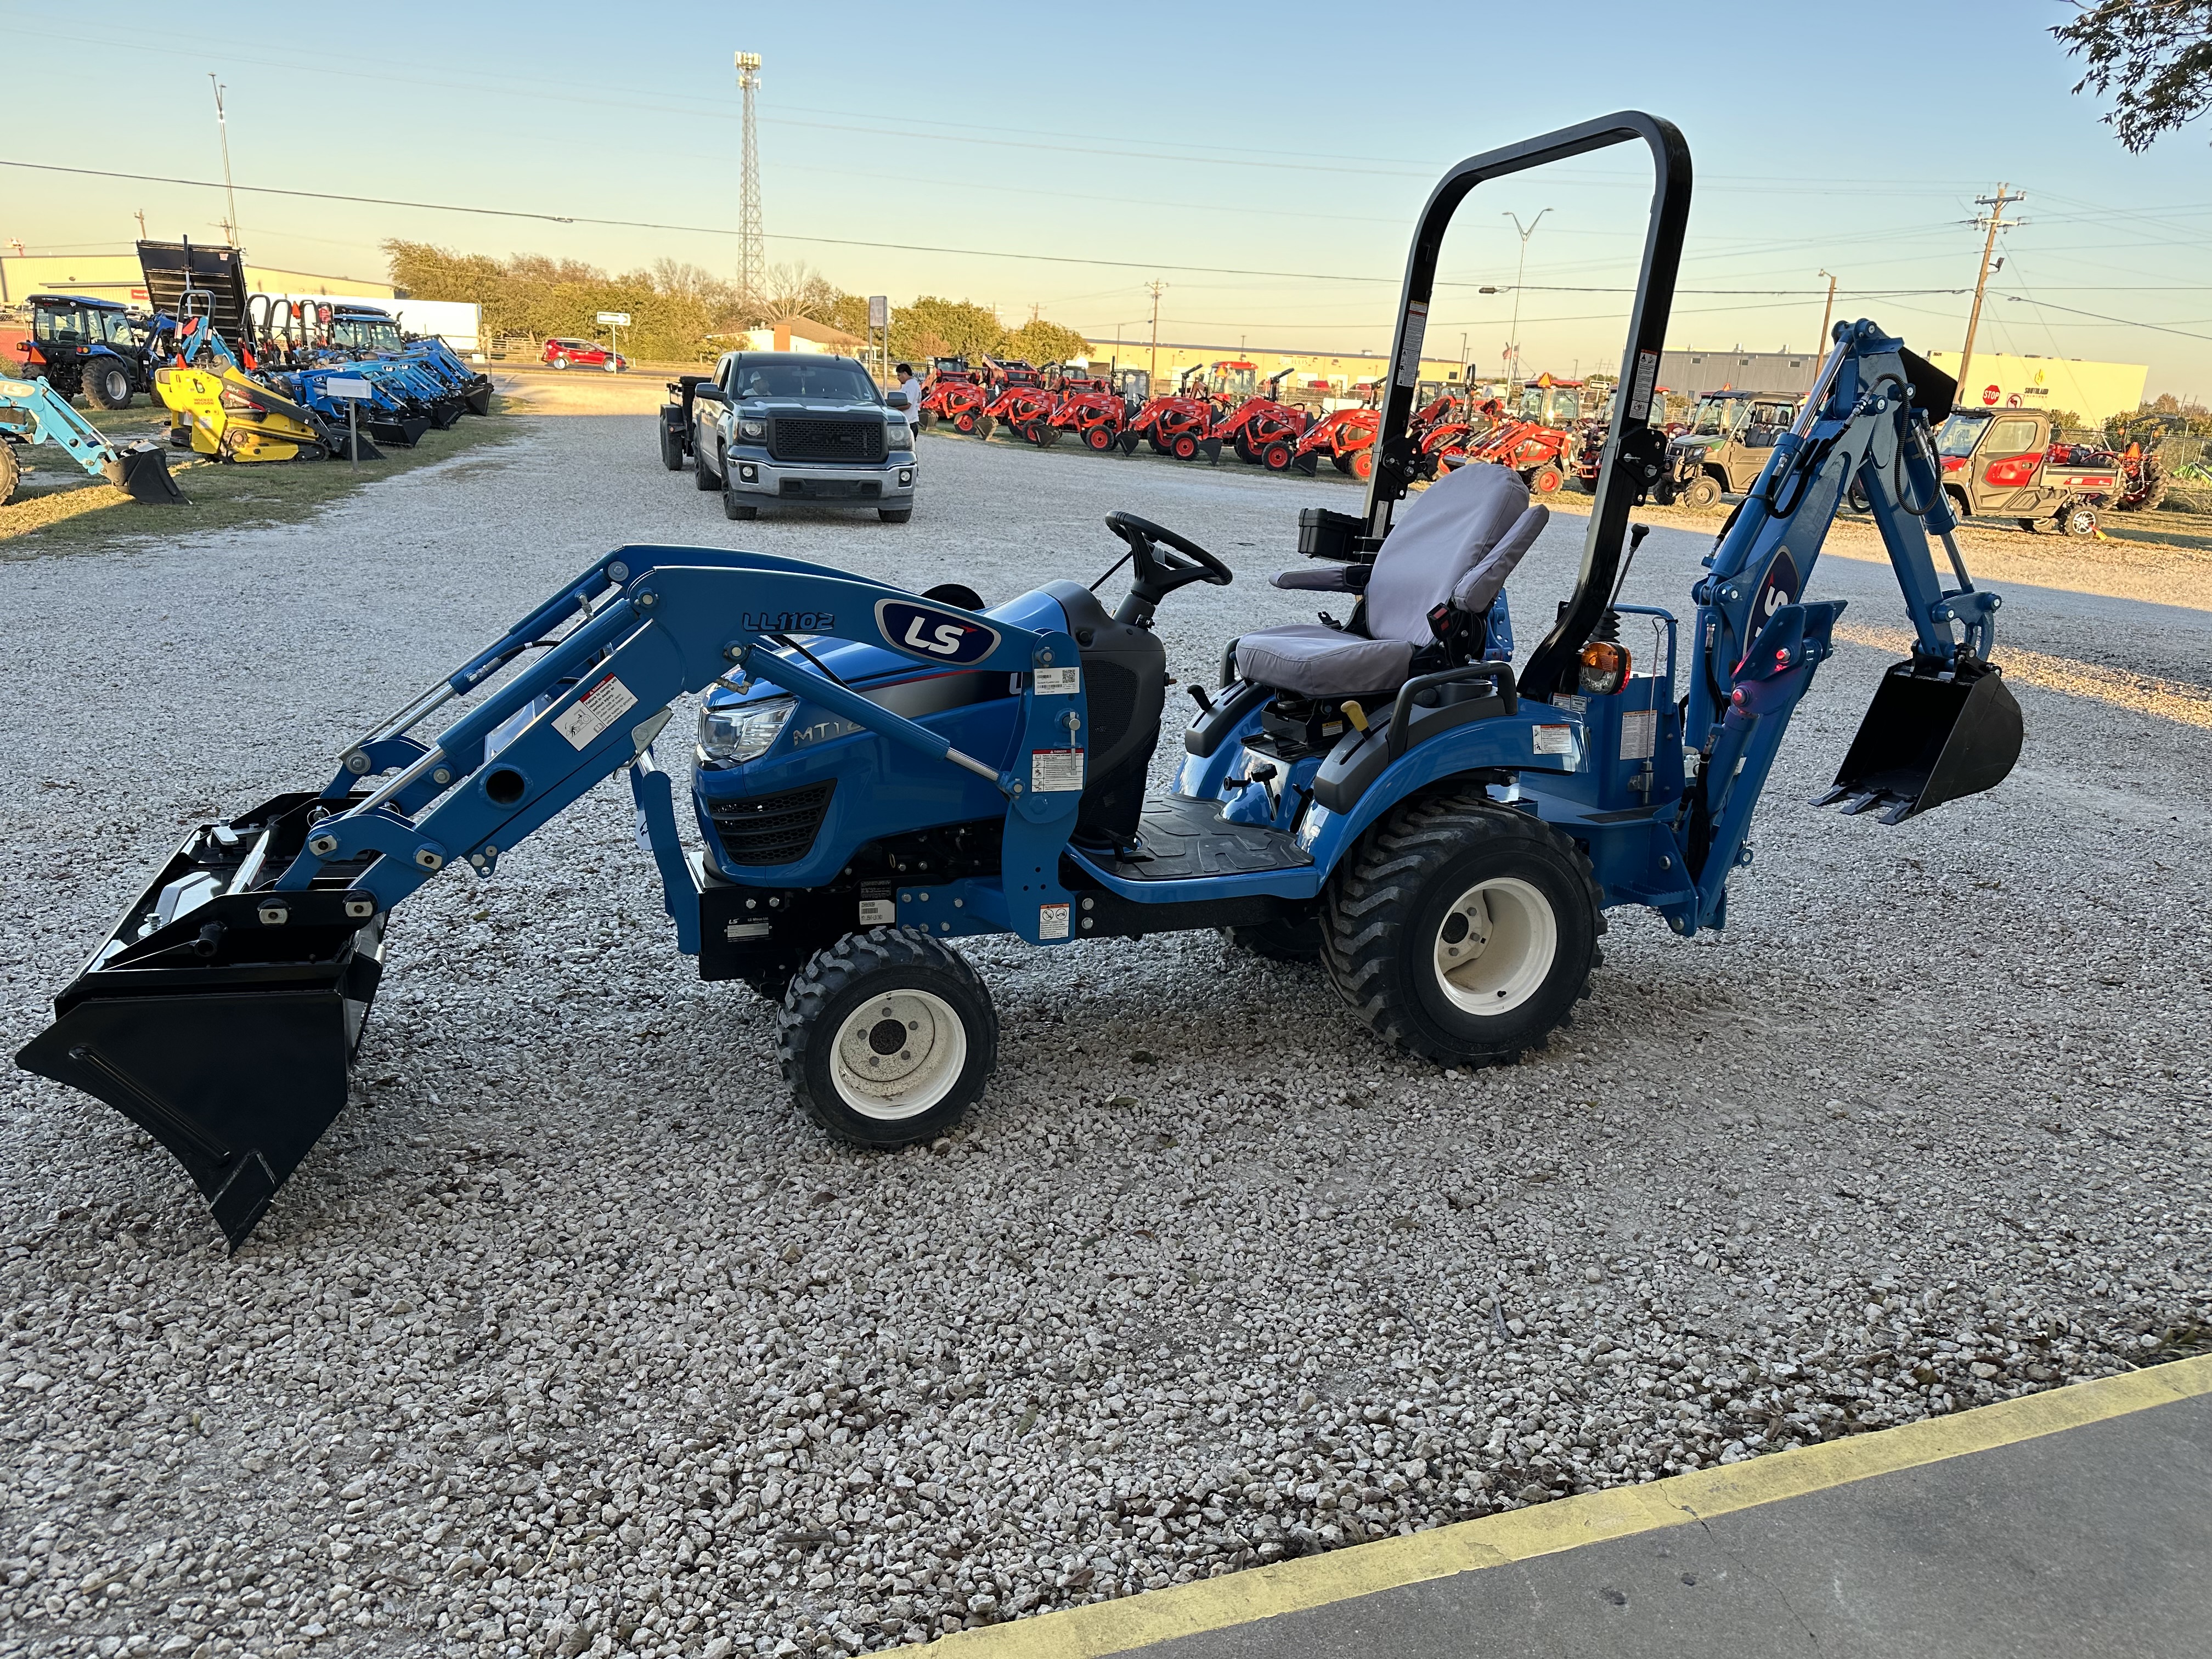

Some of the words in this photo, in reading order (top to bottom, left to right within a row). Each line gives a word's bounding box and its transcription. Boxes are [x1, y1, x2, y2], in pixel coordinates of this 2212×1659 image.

[3, 384, 27, 395] LS
[1984, 390, 2000, 400] STOP
[809, 432, 851, 444] GMC
[743, 612, 834, 631] LL1102
[904, 616, 964, 654] LS
[592, 680, 606, 692] DANGER
[585, 696, 596, 705] Failure
